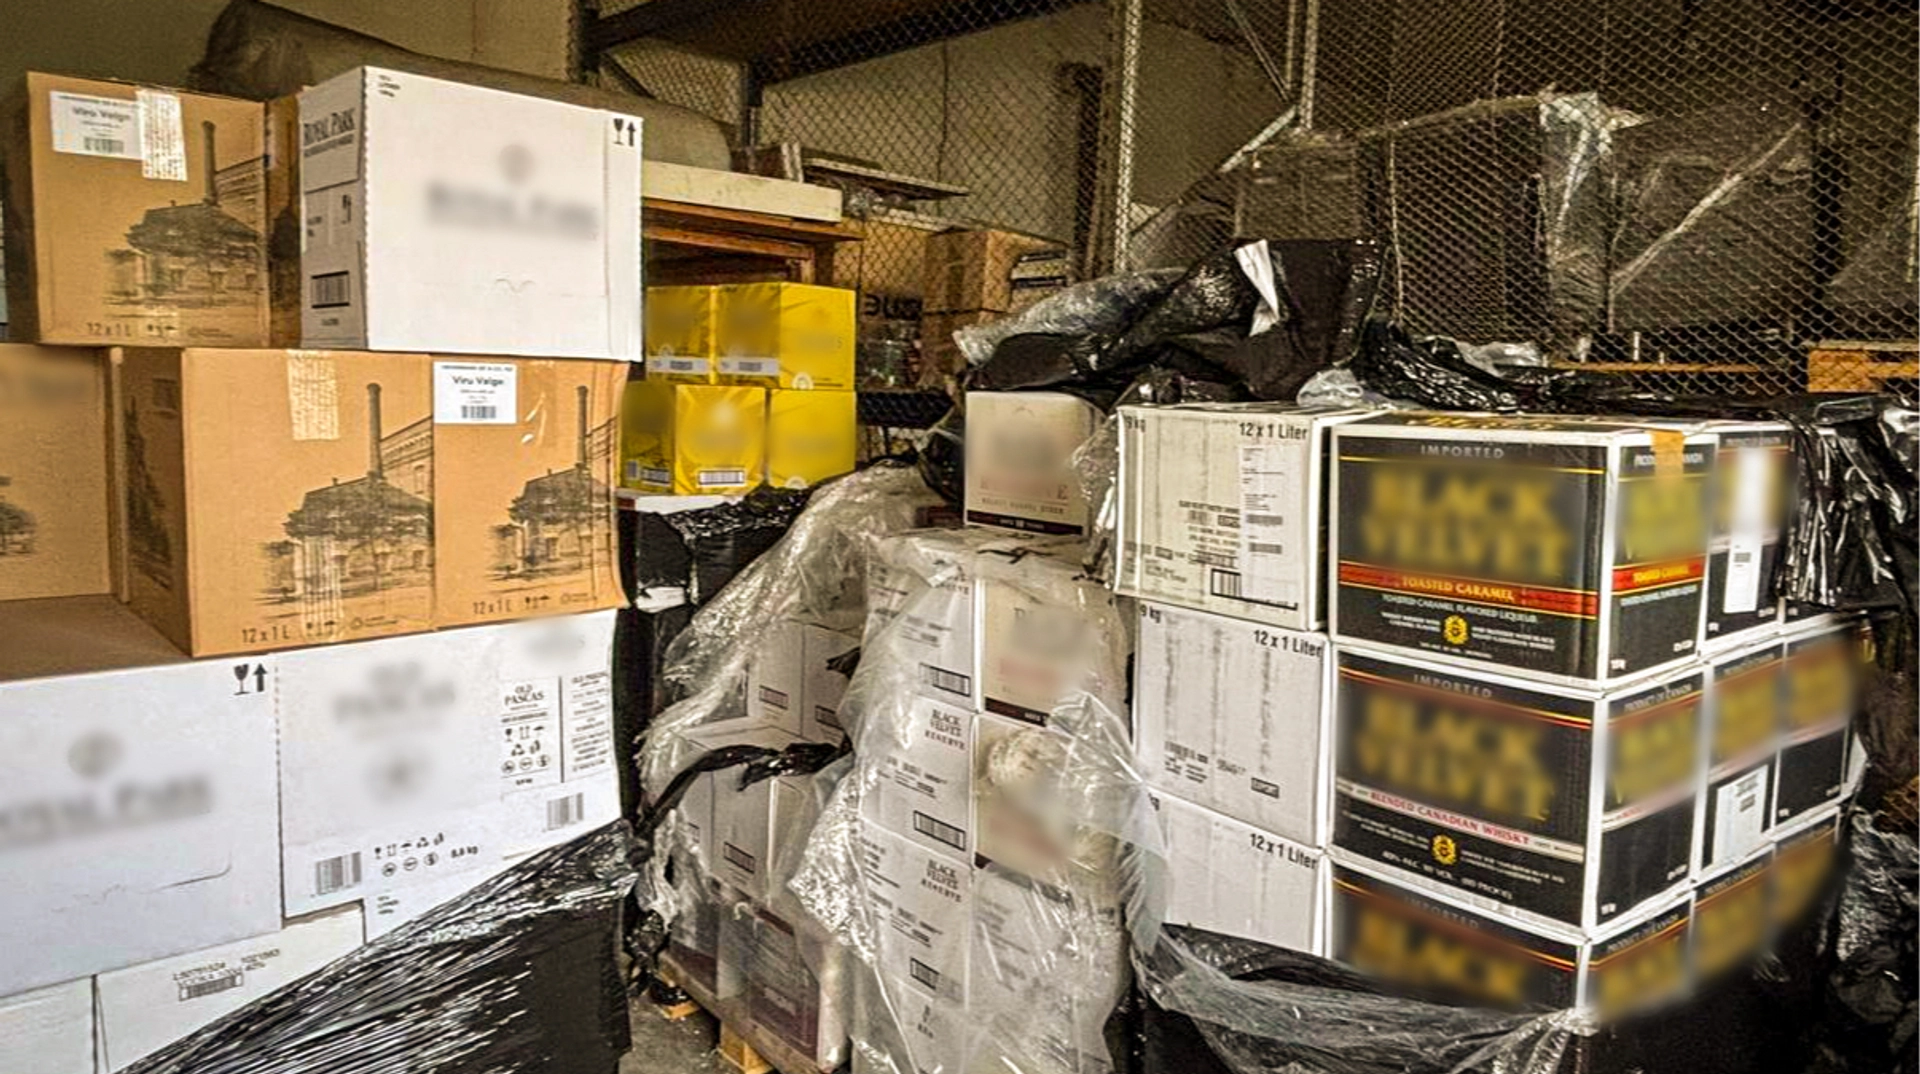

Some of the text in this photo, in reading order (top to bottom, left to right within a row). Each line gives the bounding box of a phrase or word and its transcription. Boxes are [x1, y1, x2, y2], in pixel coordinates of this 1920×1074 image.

[1239, 421, 1308, 441] 12 x 1 Liter
[1420, 444, 1504, 459] IMPORTED
[1402, 576, 1515, 601] TOASTED CARAMEL
[473, 601, 485, 614] 12
[1418, 598, 1455, 611] CARAMEL
[1149, 606, 1161, 623] kg
[242, 628, 257, 643] 12
[260, 631, 268, 641] x
[1253, 629, 1323, 658] 12 x 1 Liter
[1413, 673, 1493, 699] IMPORTED
[504, 691, 545, 706] PASCAS
[1370, 790, 1415, 813] BLENDED
[1417, 805, 1479, 832] CANADIAN
[1250, 833, 1318, 870] 12 x 1 Liter
